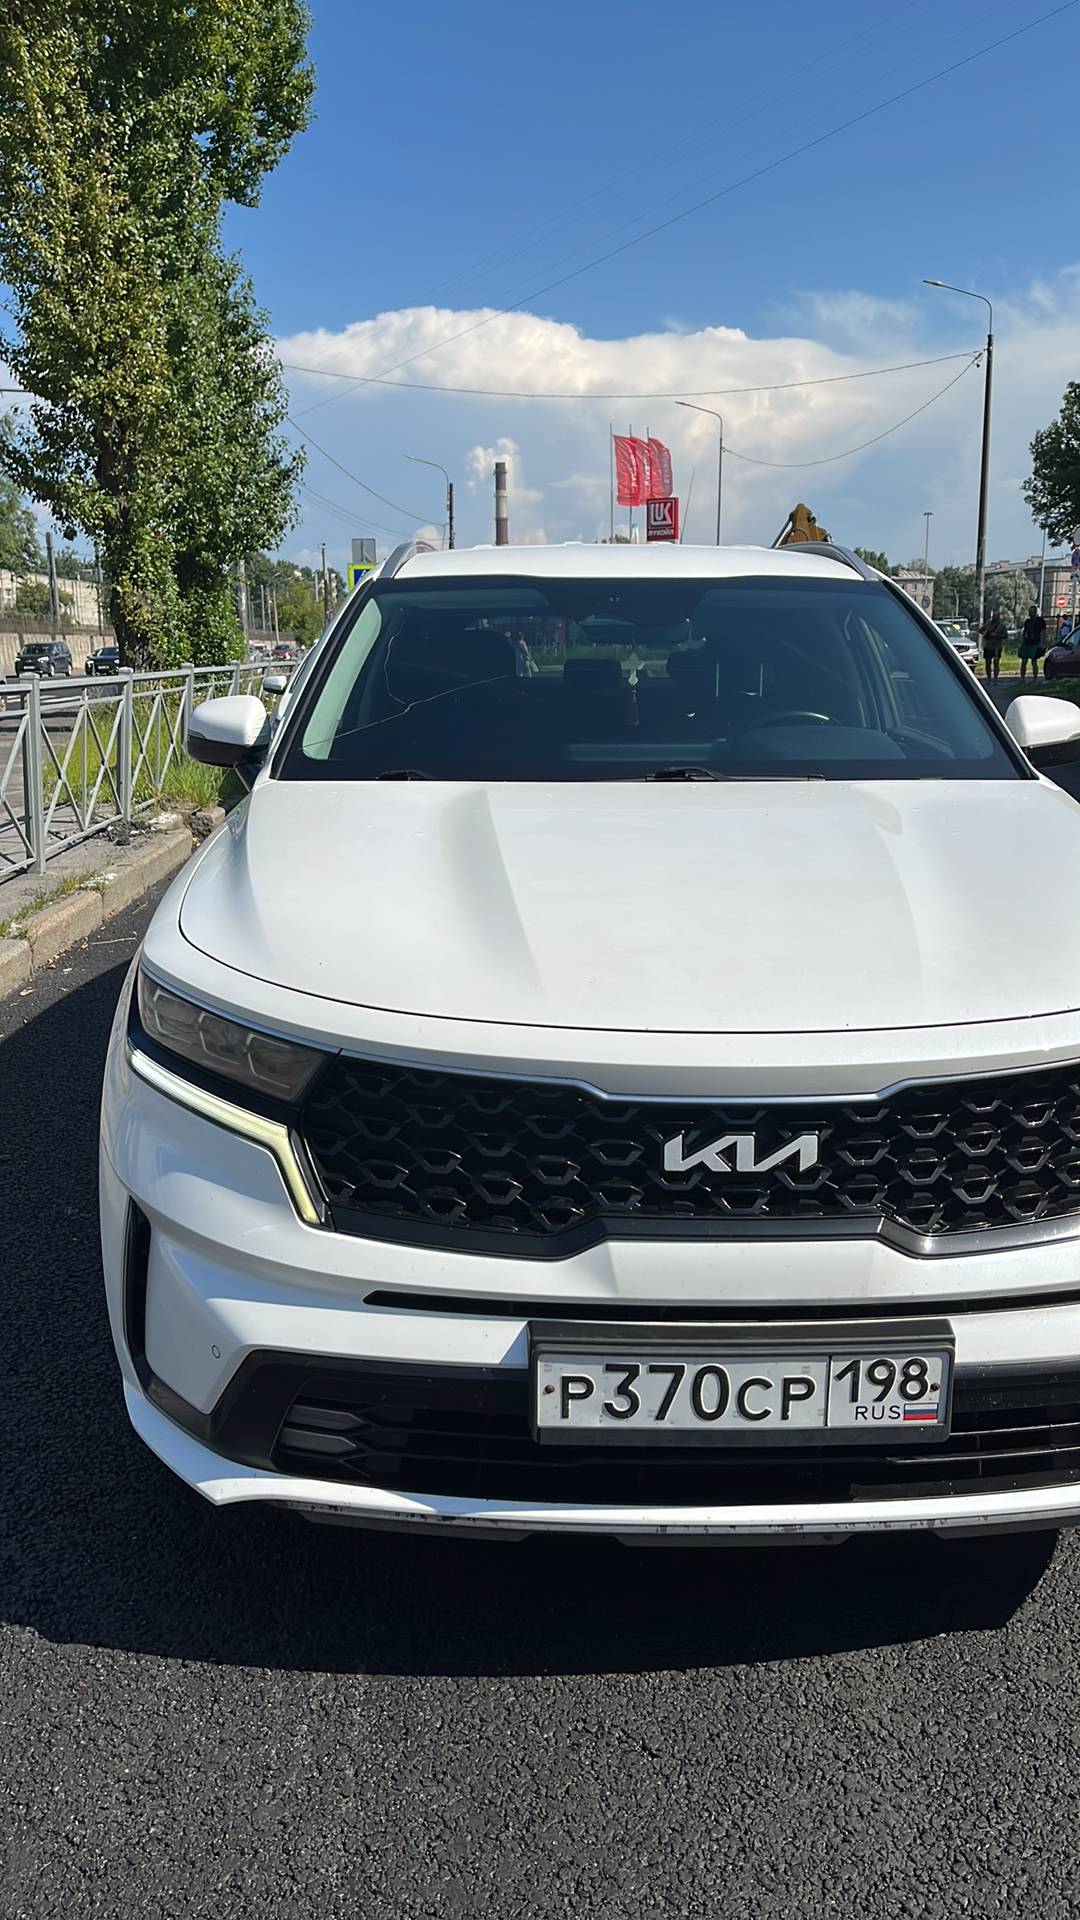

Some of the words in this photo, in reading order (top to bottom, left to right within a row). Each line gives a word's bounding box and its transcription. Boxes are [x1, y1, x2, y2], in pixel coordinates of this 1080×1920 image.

[664, 1134, 818, 1172] KIA
[834, 1358, 929, 1402] 198
[855, 1405, 901, 1420] RUS
